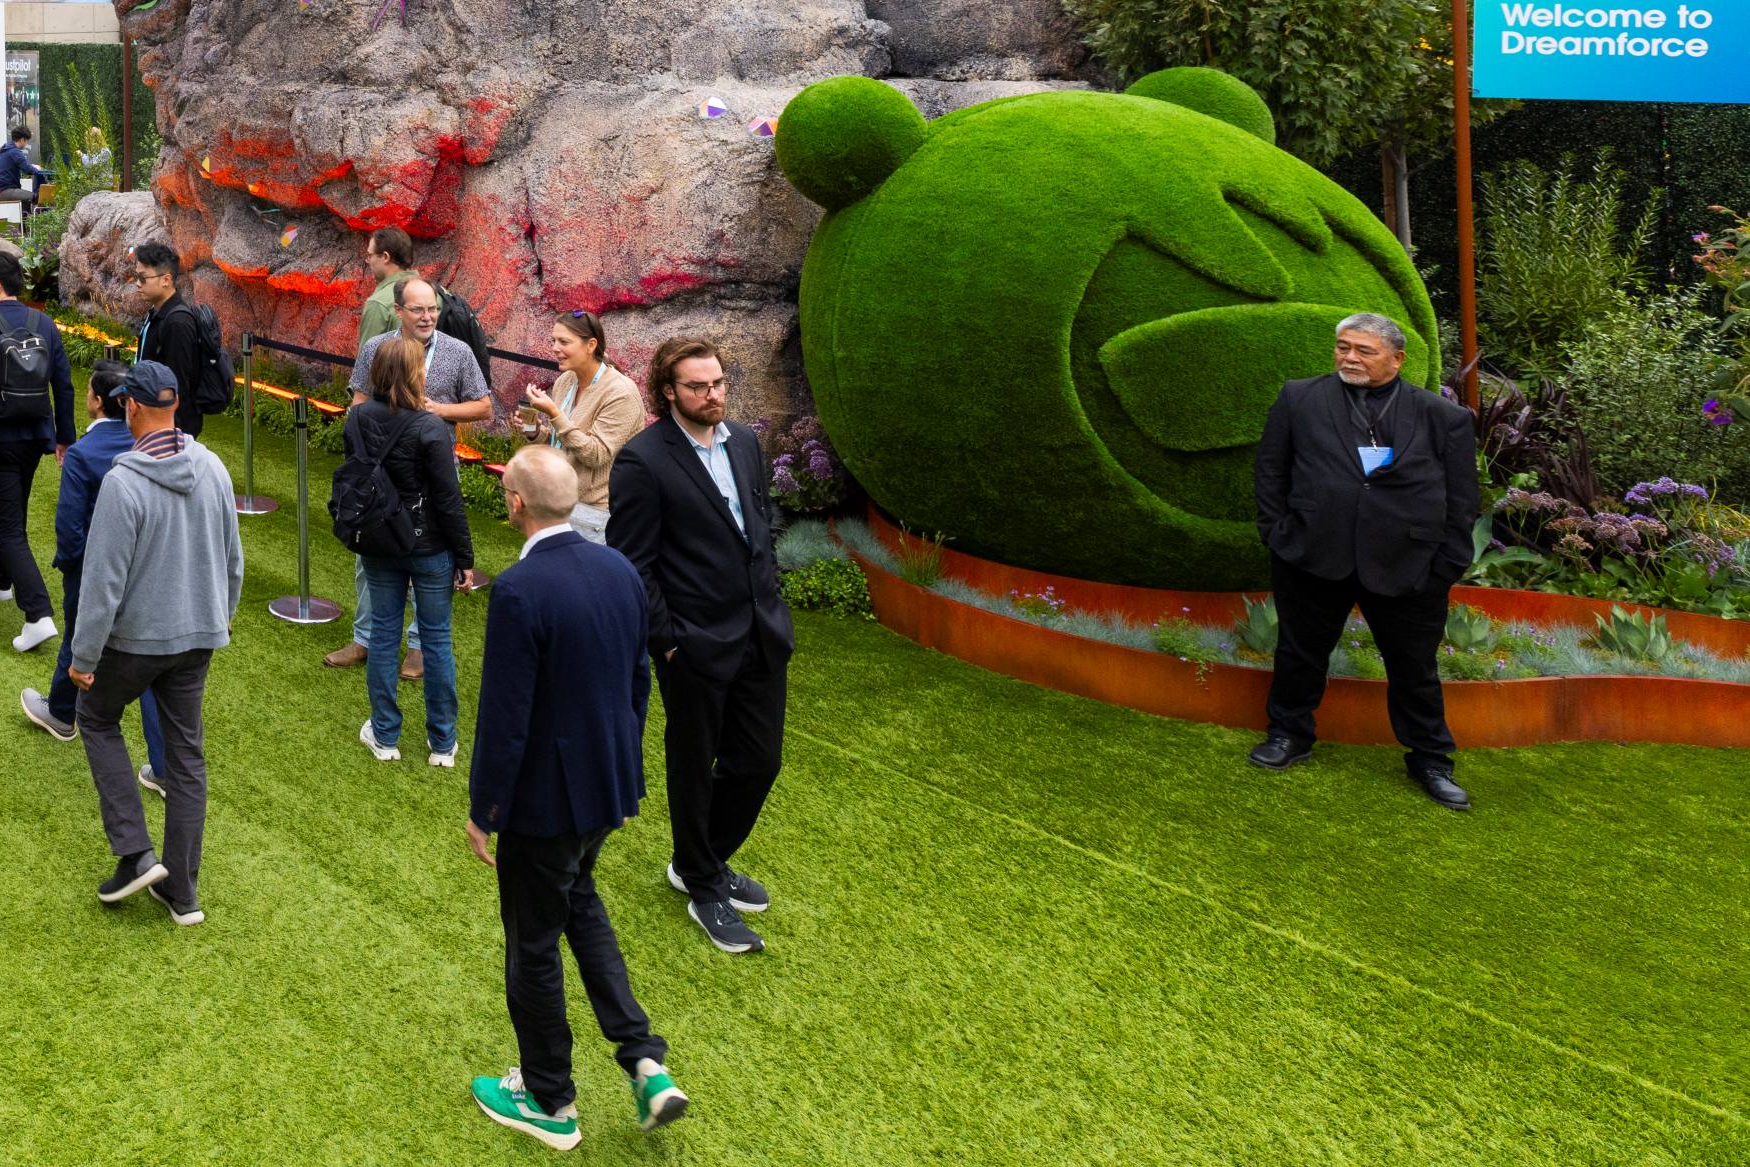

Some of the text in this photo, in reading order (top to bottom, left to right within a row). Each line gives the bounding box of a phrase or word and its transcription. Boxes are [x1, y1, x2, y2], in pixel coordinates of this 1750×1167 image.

[1500, 3, 1713, 29] Welcome to
[1501, 31, 1709, 57] Dreamforce
[5, 58, 32, 74] ustpilot
